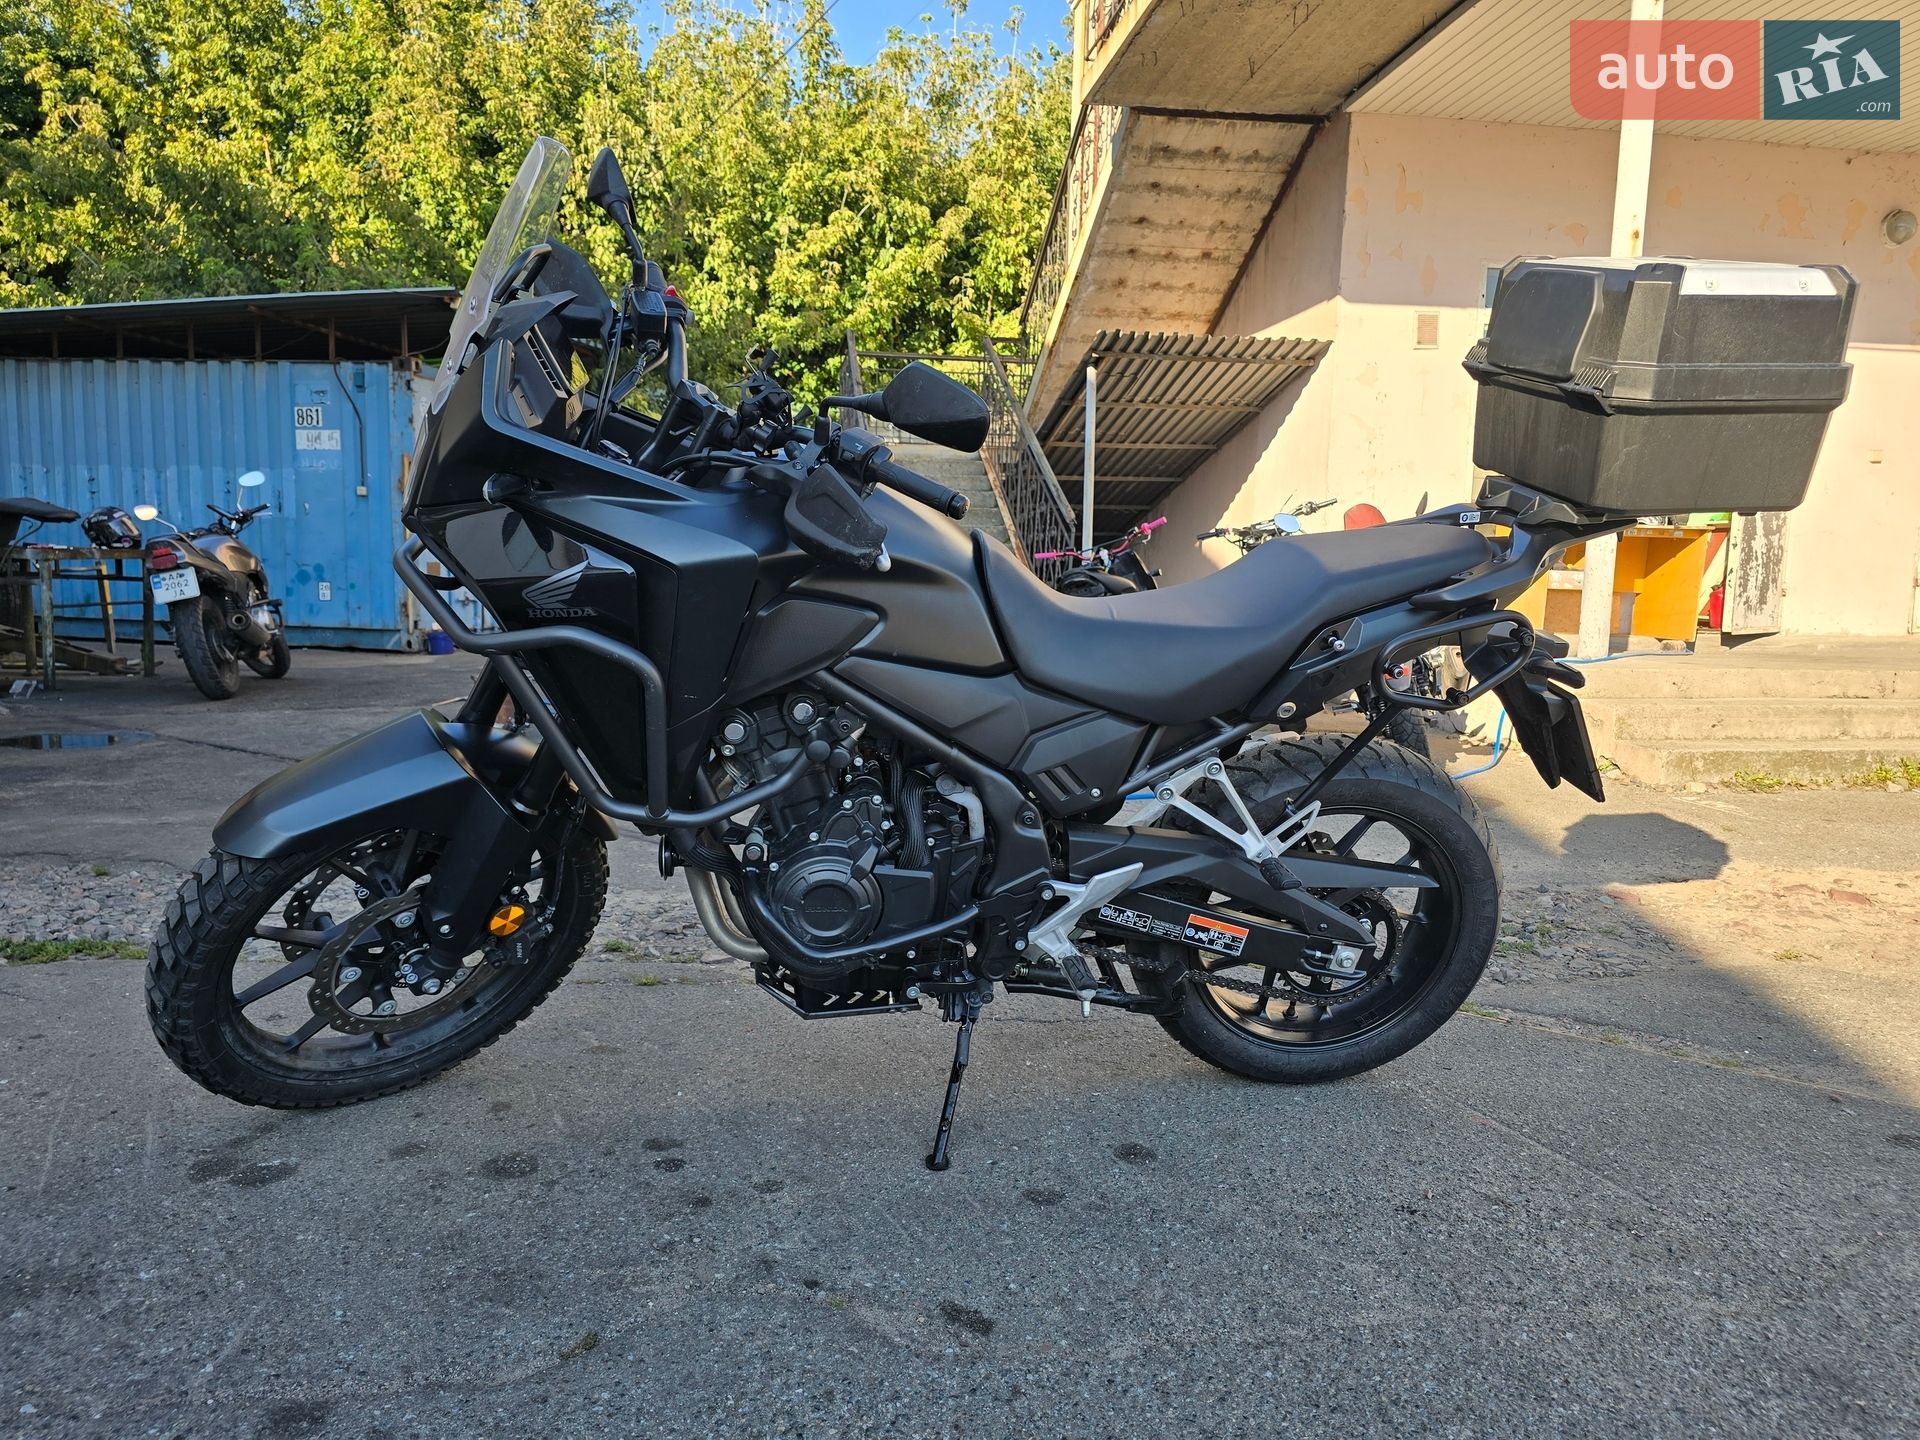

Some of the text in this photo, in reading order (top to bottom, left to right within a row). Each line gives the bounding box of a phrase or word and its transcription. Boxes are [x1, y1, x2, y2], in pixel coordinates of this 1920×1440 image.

[296, 408, 320, 426] 861
[164, 579, 189, 591] 2062
[528, 608, 598, 618] HONDA
